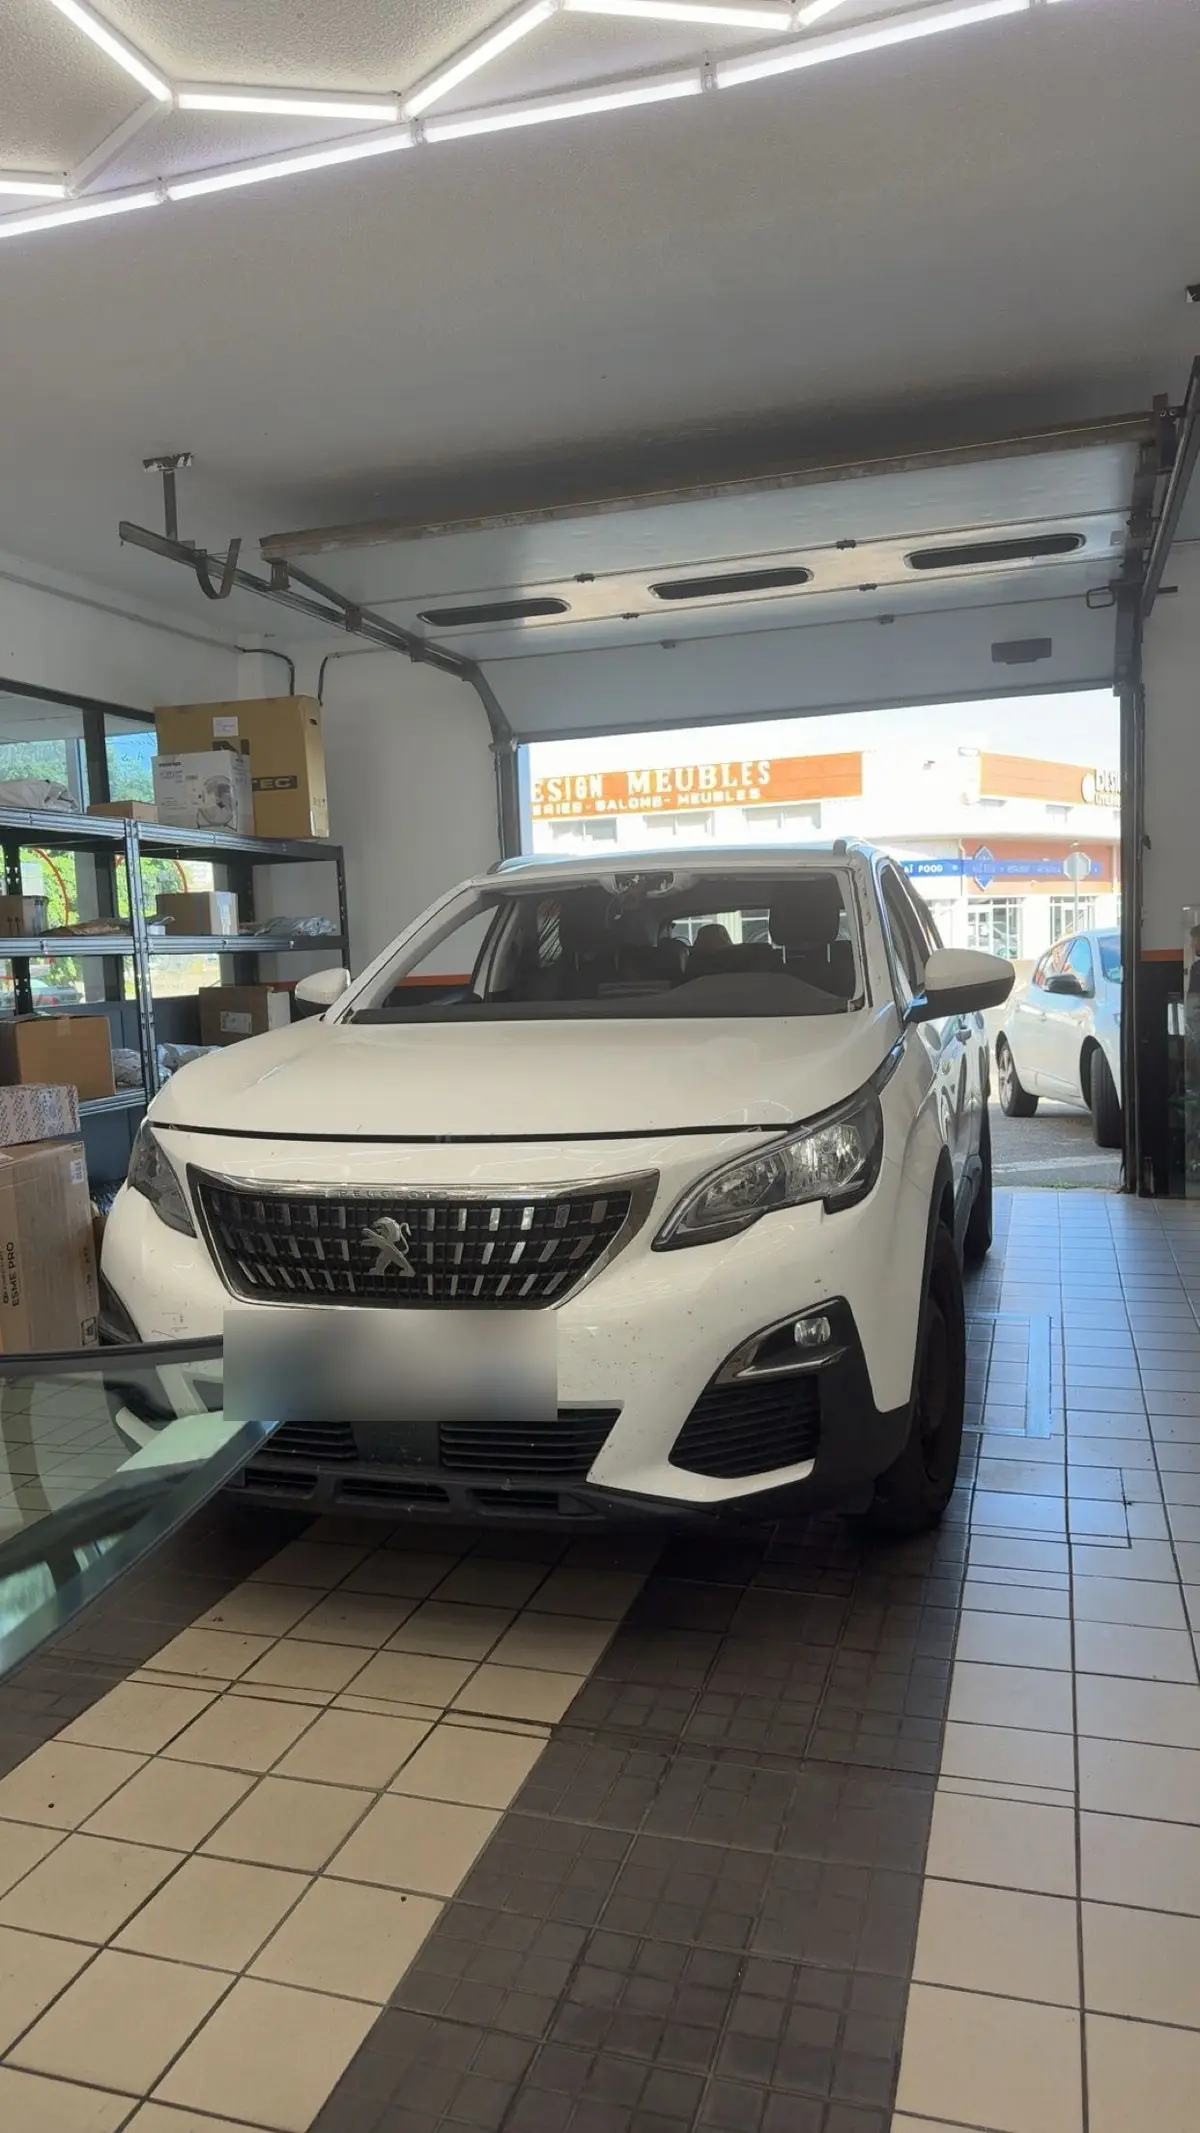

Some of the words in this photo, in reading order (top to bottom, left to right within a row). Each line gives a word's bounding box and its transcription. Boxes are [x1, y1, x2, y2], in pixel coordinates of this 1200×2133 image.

[626, 760, 771, 795] MEUBLES
[918, 864, 944, 873] FOOD
[6, 1242, 16, 1270] PRO
